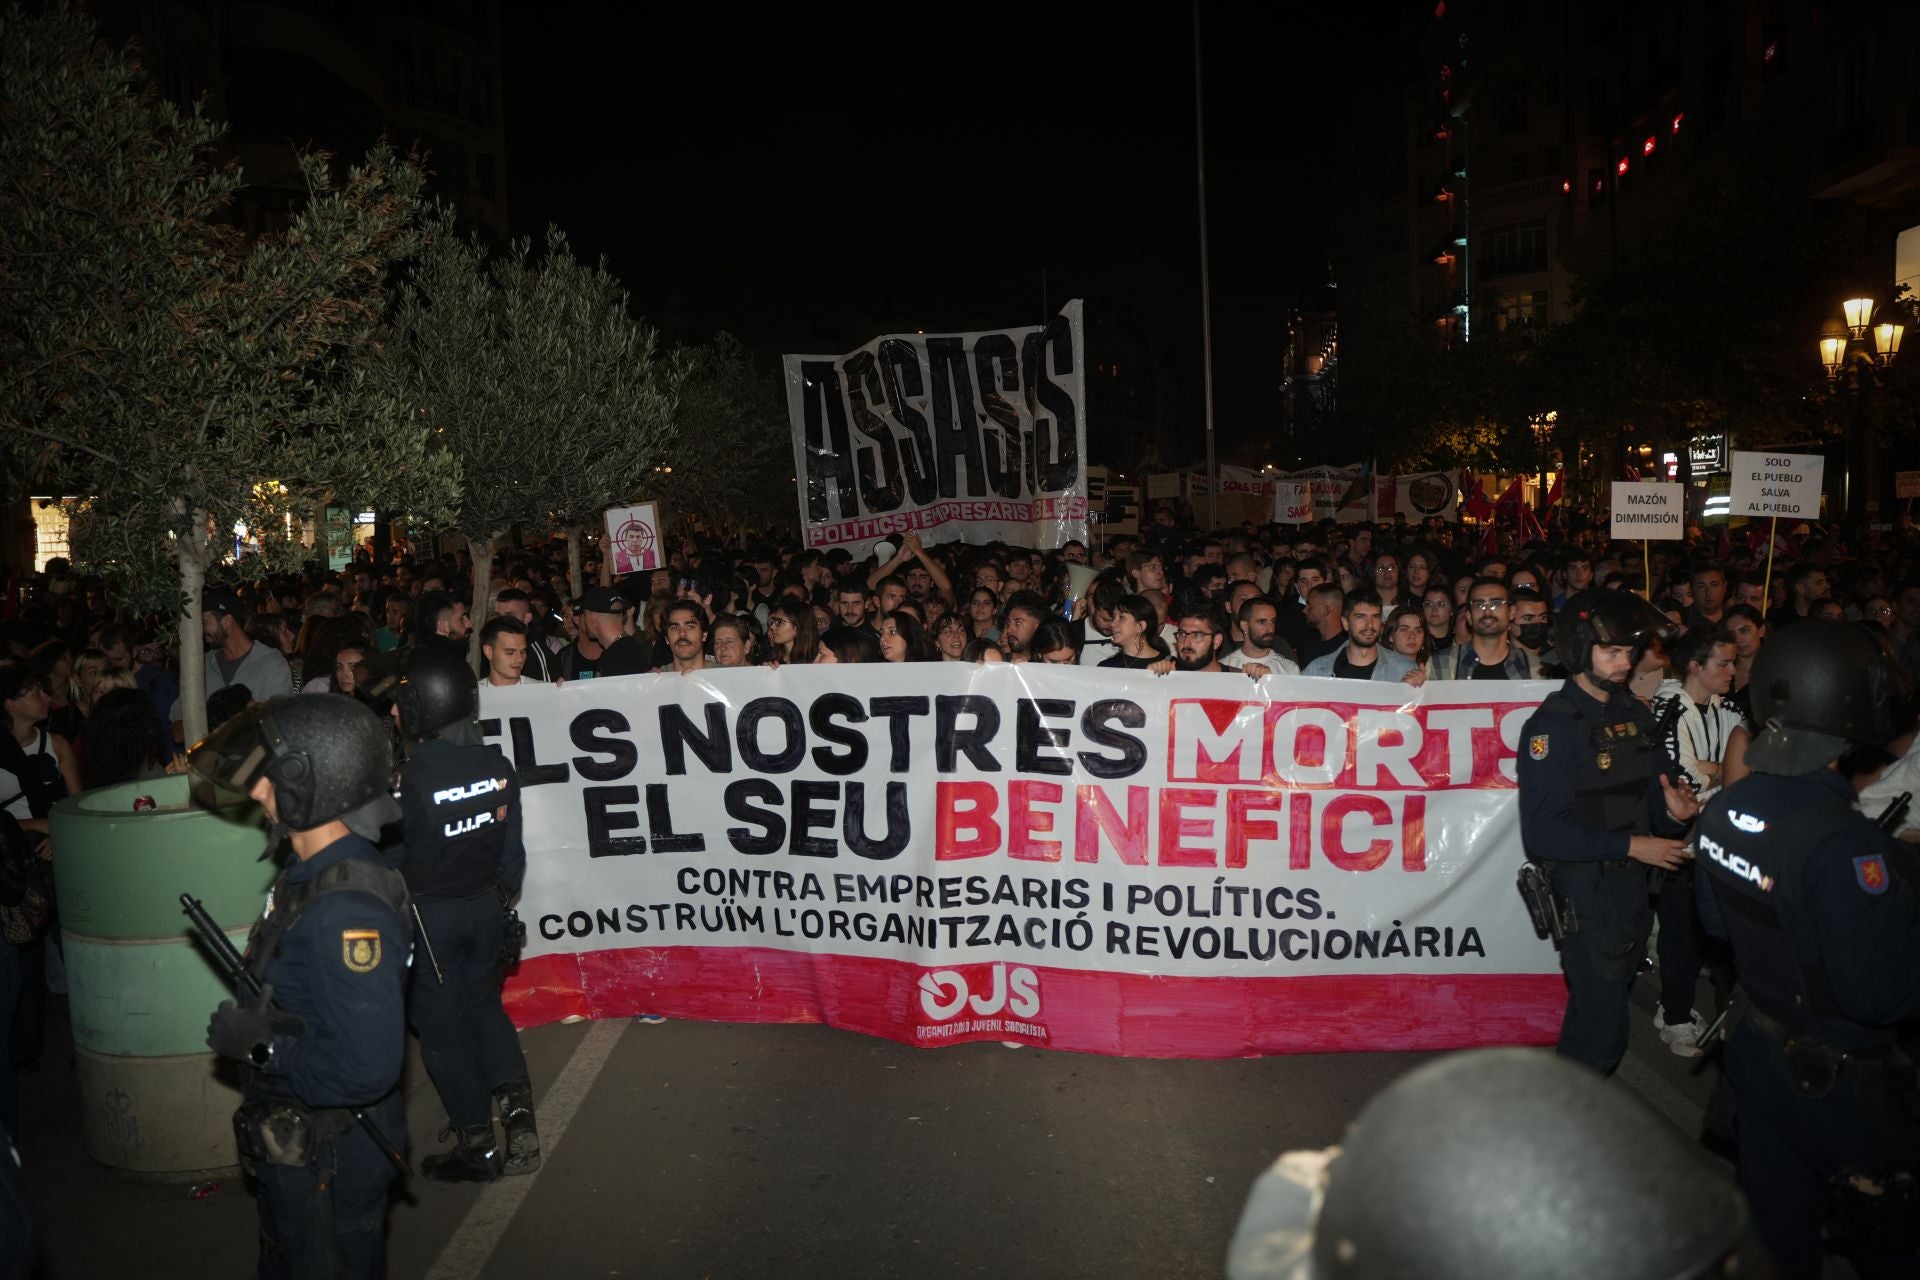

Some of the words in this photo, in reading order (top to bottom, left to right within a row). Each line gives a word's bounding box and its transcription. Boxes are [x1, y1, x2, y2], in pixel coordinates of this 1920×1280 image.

[1765, 457, 1791, 467] SOLO
[1751, 472, 1762, 481] EL
[1764, 473, 1802, 483] PUEBLO
[1627, 492, 1667, 505] MAZÓN
[1761, 488, 1790, 498] SALVA
[921, 501, 1029, 528] EMPRESARIS
[1748, 502, 1760, 512] AL
[1763, 503, 1801, 513] PUEBLO
[1615, 512, 1679, 524] DIMIMISIÓN
[659, 692, 1147, 780] NOSTRES
[583, 783, 705, 858] EL
[724, 778, 912, 860] SEU
[935, 780, 1427, 872] BENEFICI
[677, 867, 825, 902] CONTRA
[835, 873, 1090, 910] EMPRESARIS
[1102, 882, 1114, 912] I
[1127, 876, 1336, 920] POLÍTICS.
[539, 898, 765, 941] CONSTRUÏM
[774, 906, 1094, 951] L'ORGANITZACIÓ
[1106, 919, 1486, 962] REVOLUCIONÀRIA
[917, 964, 1041, 1020] OJS
[971, 1019, 1004, 1033] JUVENIL
